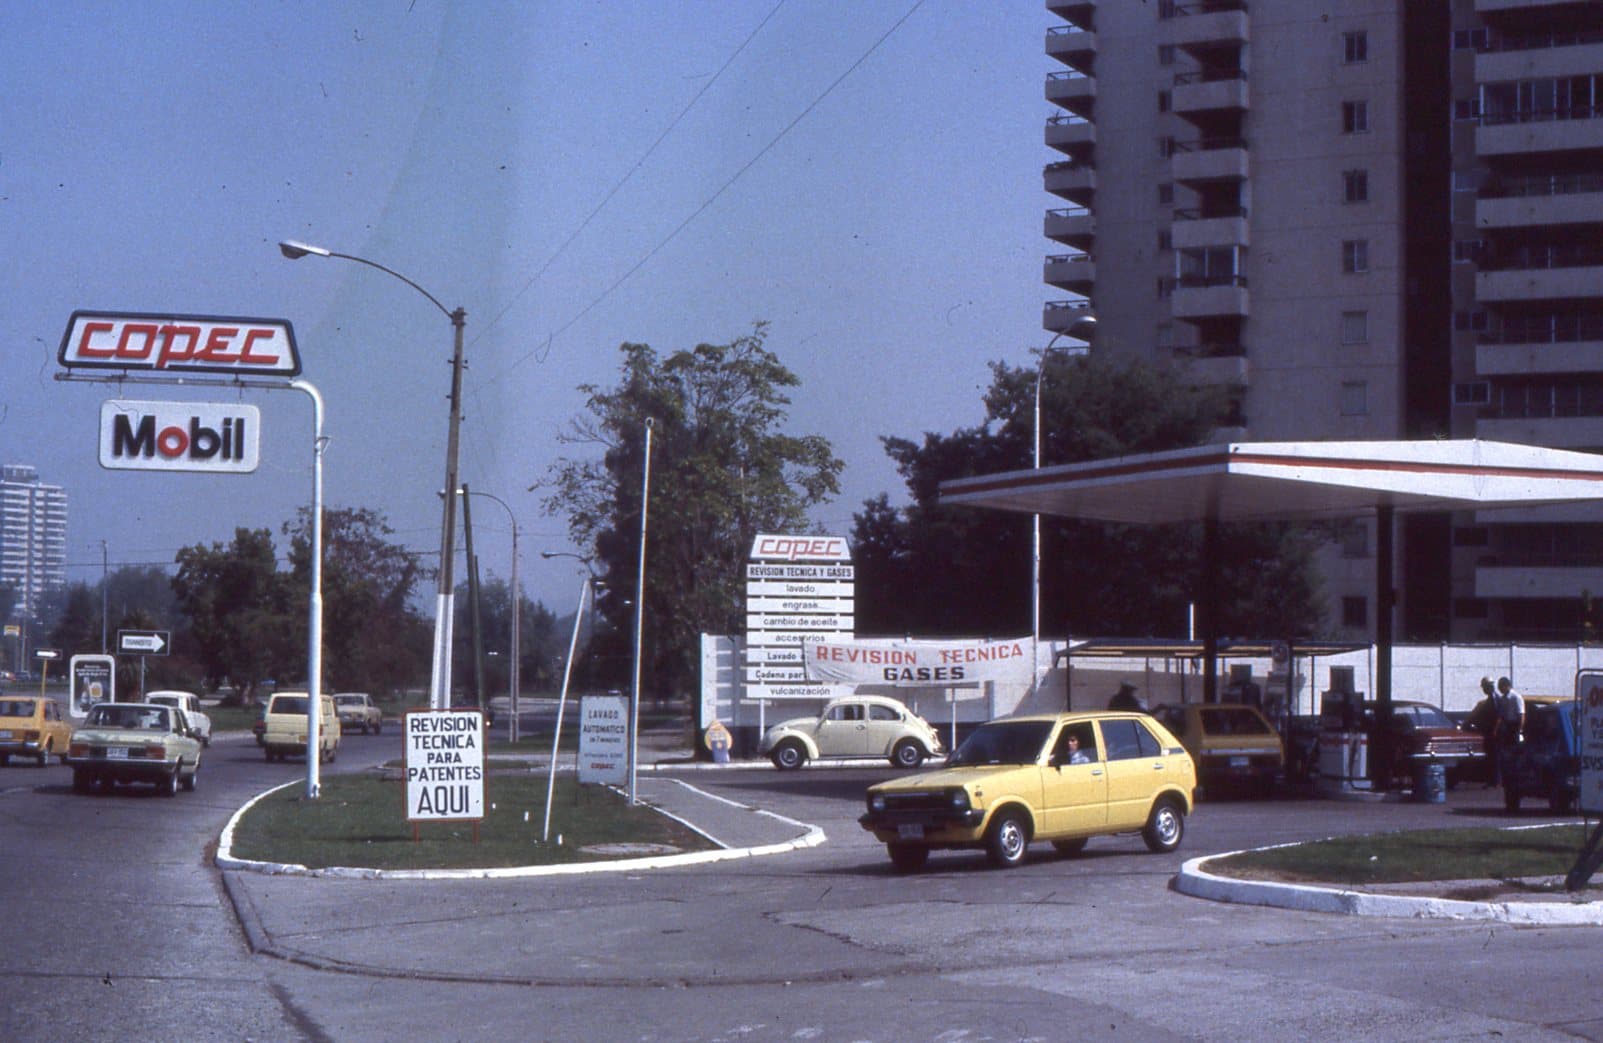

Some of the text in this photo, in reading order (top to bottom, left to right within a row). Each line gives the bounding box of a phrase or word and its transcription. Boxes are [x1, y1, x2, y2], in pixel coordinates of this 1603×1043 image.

[112, 413, 245, 461] Mobil
[750, 566, 852, 577] REVISION TECNICA Y GASES
[786, 584, 815, 593] lavado
[782, 601, 819, 611] engrase
[763, 618, 838, 626] cambio de aceite
[767, 651, 797, 660] Lavado
[816, 643, 1023, 665] REVISION TECNICA
[755, 670, 785, 679] Cadena
[884, 666, 965, 681] GASES
[770, 686, 831, 696] vulcanización
[588, 709, 619, 719] LAVADO
[410, 716, 478, 733] REVISION
[412, 734, 476, 750] TECNICA
[427, 752, 462, 764] PARA
[408, 766, 481, 782] PATENTES
[417, 785, 470, 815] AQUI
